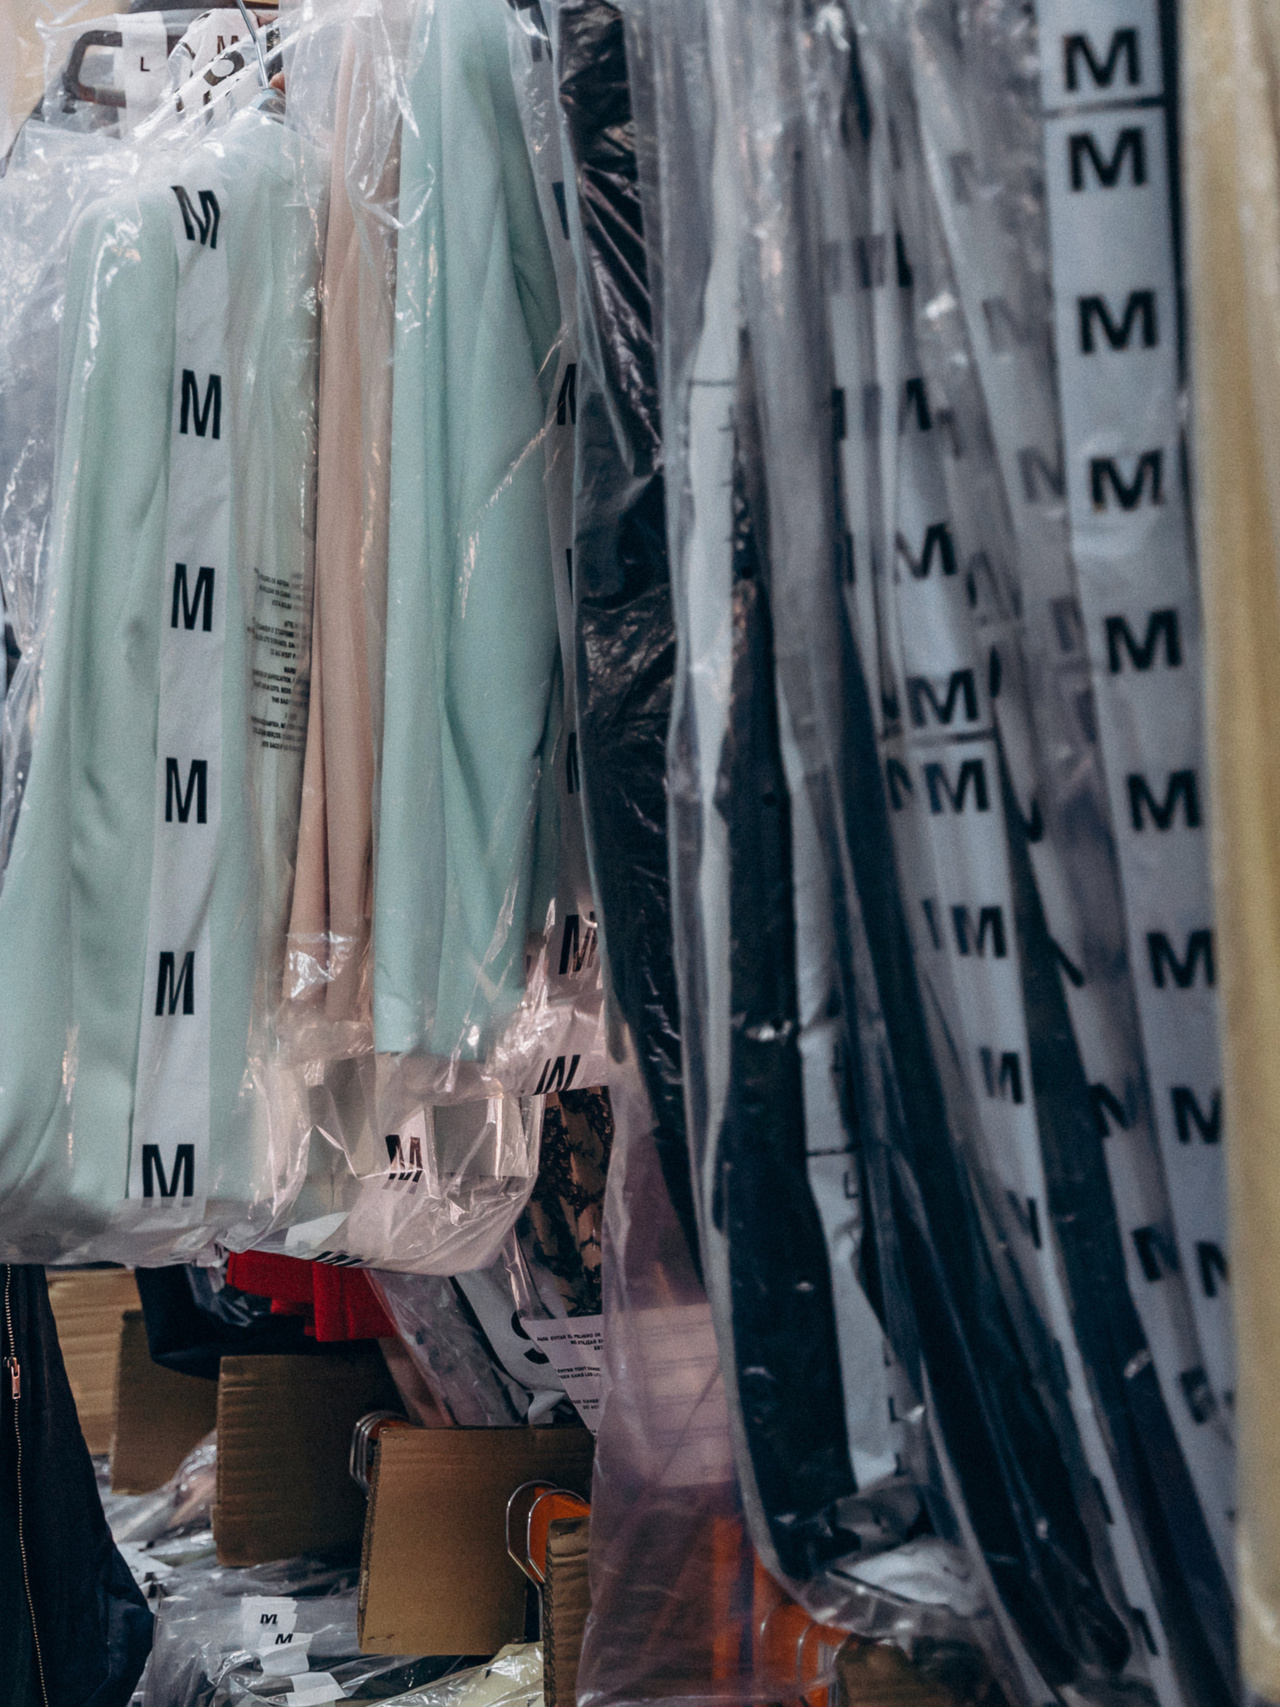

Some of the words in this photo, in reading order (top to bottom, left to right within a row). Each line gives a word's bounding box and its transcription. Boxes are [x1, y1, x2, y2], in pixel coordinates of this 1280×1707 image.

[140, 57, 150, 71] L
[1062, 28, 1142, 93] M
[1068, 126, 1148, 193] M
[171, 185, 220, 249] M
[1078, 290, 1159, 355] M
[179, 369, 222, 439] M
[1089, 449, 1163, 515] M
[171, 563, 215, 632] M
[1106, 609, 1182, 674] M
[907, 668, 978, 728] M
[164, 757, 207, 824] M
[924, 759, 989, 815] M
[1127, 769, 1202, 832] M
[155, 951, 195, 1016] M
[1146, 930, 1216, 989] M
[141, 1143, 195, 1198] M
[385, 1134, 423, 1180] M
[260, 1614, 277, 1624] M
[275, 1634, 293, 1645] M
